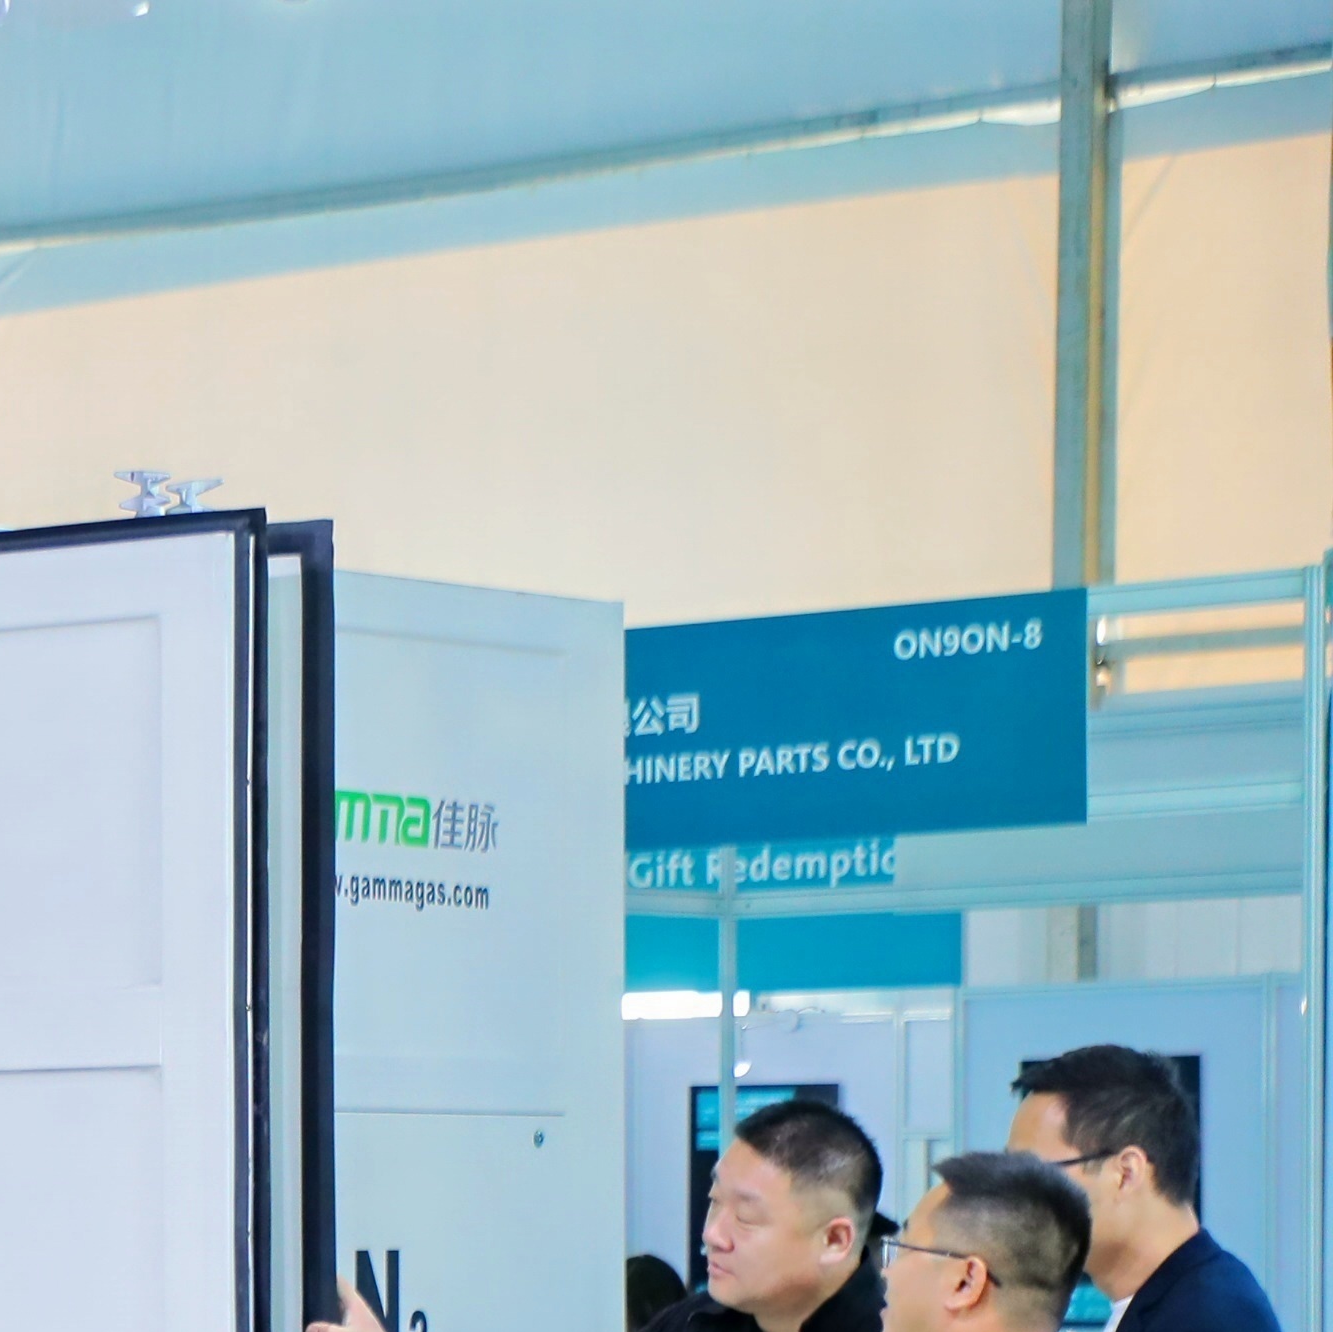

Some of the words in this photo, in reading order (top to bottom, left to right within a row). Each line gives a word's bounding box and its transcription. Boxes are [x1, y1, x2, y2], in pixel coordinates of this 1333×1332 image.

[623, 692, 700, 737] 公司
[738, 742, 830, 777] PARTS
[837, 737, 895, 772] CO.,
[904, 732, 960, 768] LTD
[629, 848, 694, 888] Gift
